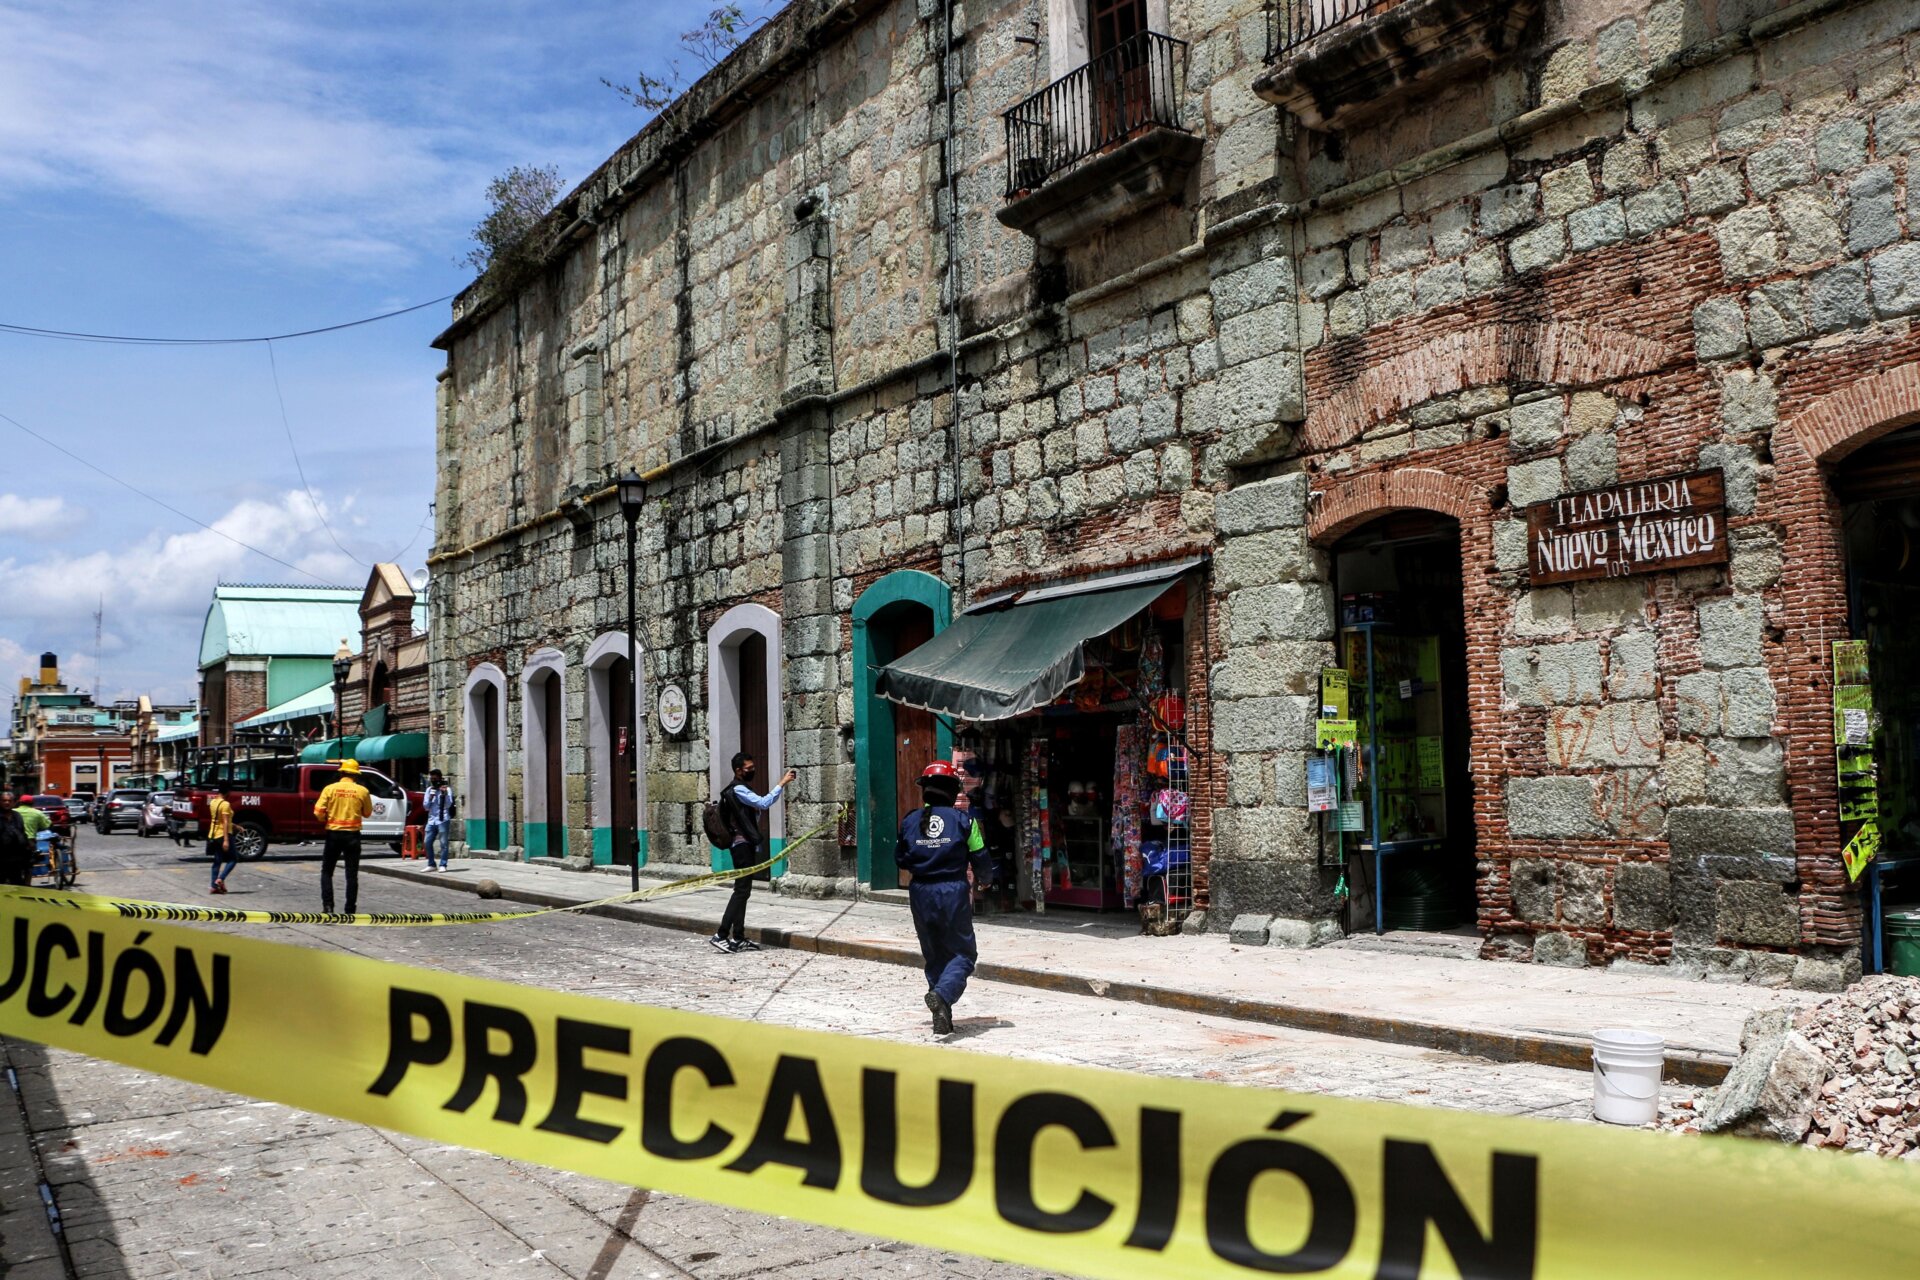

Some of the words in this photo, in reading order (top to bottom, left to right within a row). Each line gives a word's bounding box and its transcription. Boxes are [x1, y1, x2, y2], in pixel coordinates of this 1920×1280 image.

[1537, 528, 1609, 575] Nuevo
[1604, 560, 1631, 578] 106
[241, 795, 261, 806] PC-001
[366, 986, 1538, 1280] PRECAUCIÓN
